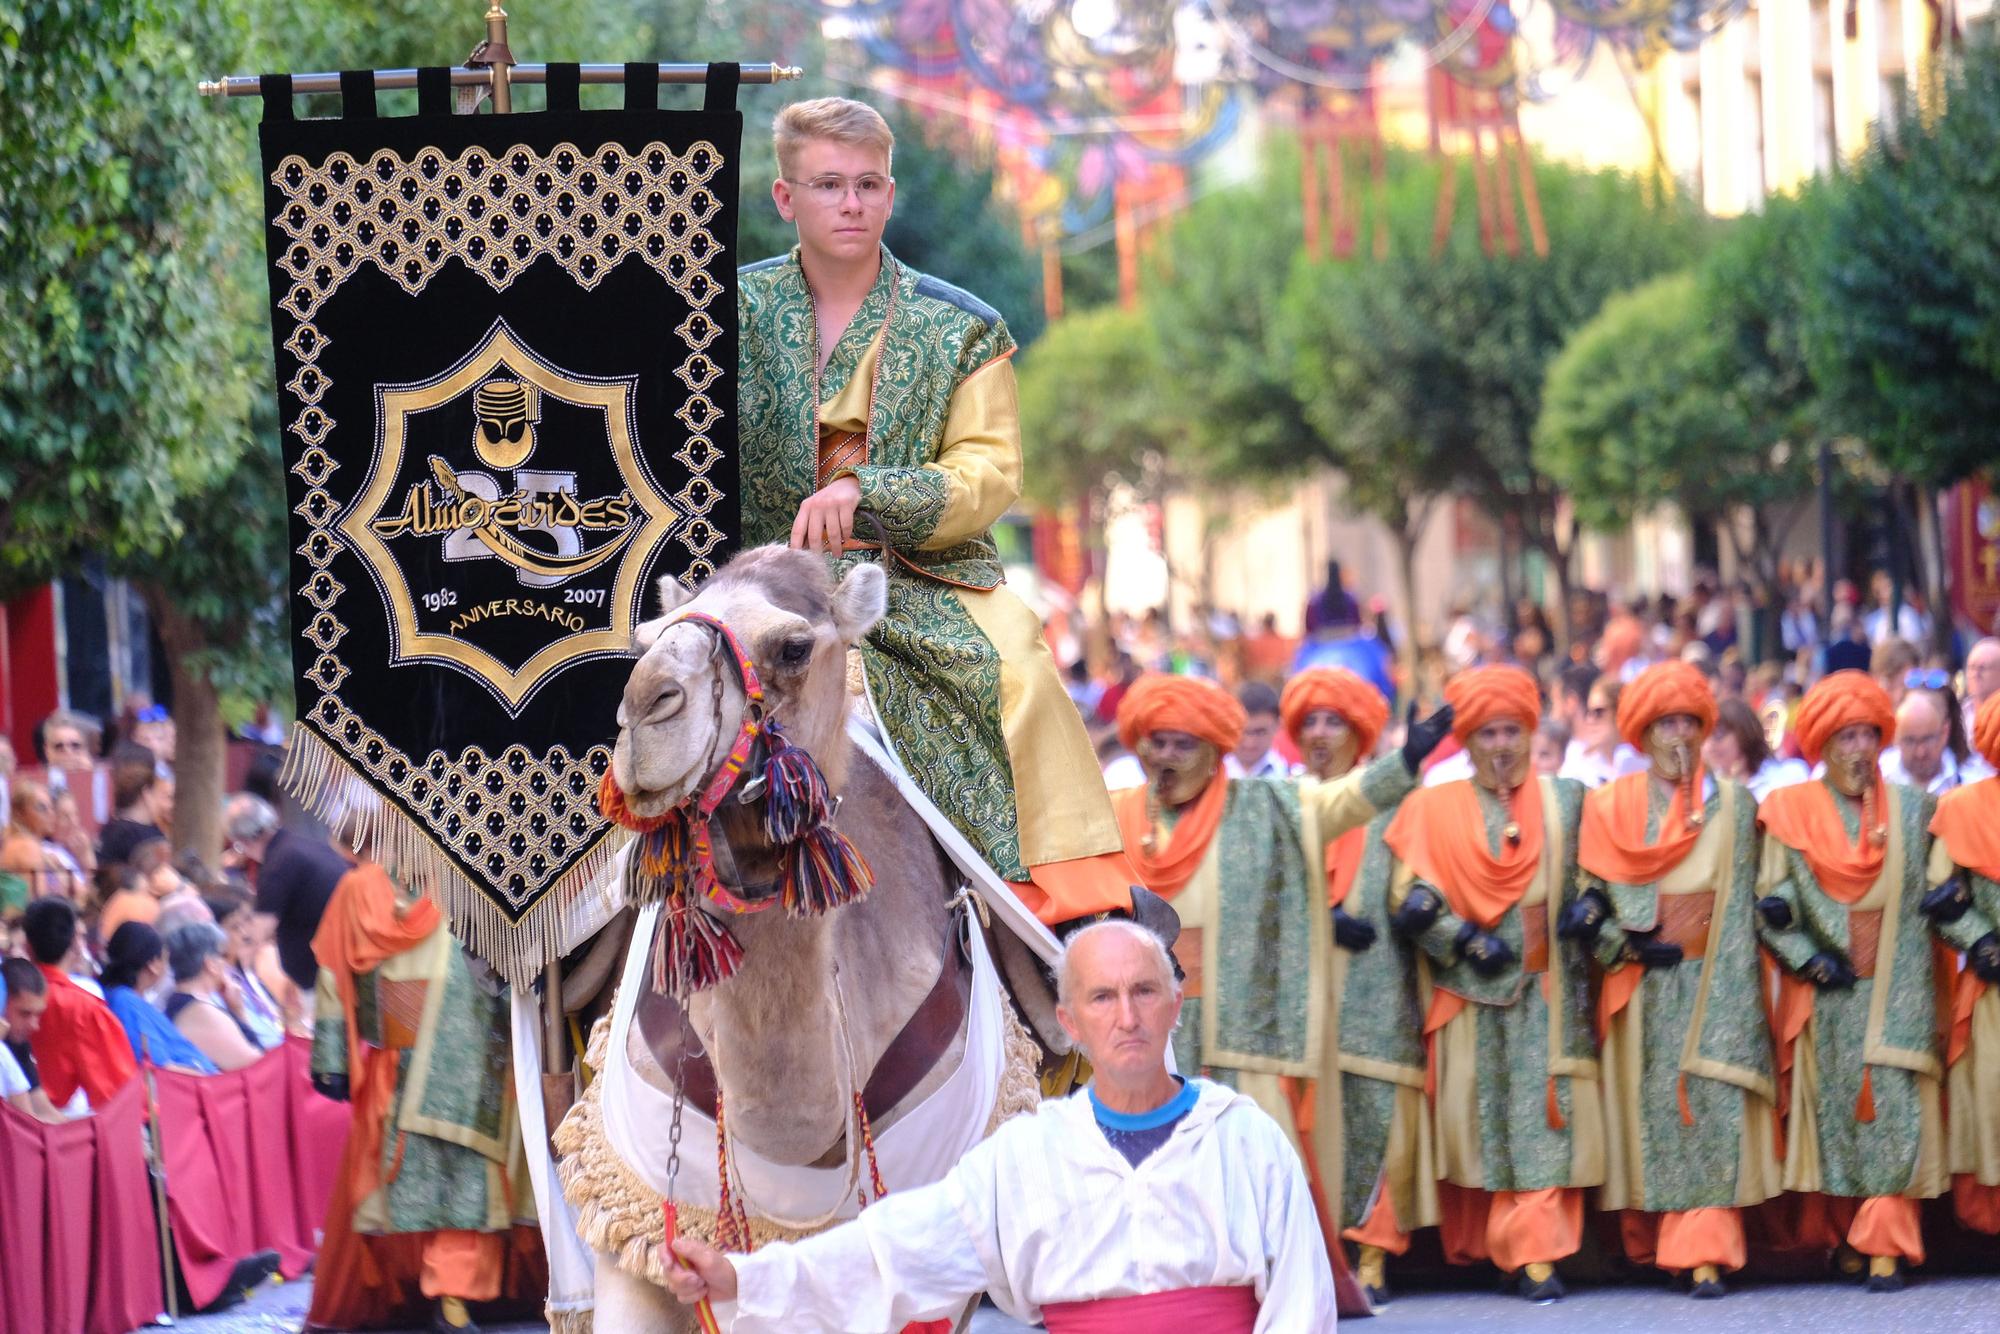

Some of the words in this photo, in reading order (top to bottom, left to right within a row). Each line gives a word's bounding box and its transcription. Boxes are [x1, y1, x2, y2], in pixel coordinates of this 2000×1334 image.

[445, 472, 581, 587] 25
[421, 587, 458, 612] 1982
[563, 588, 606, 608] 2007
[450, 599, 584, 636] ANIVERSARIO
